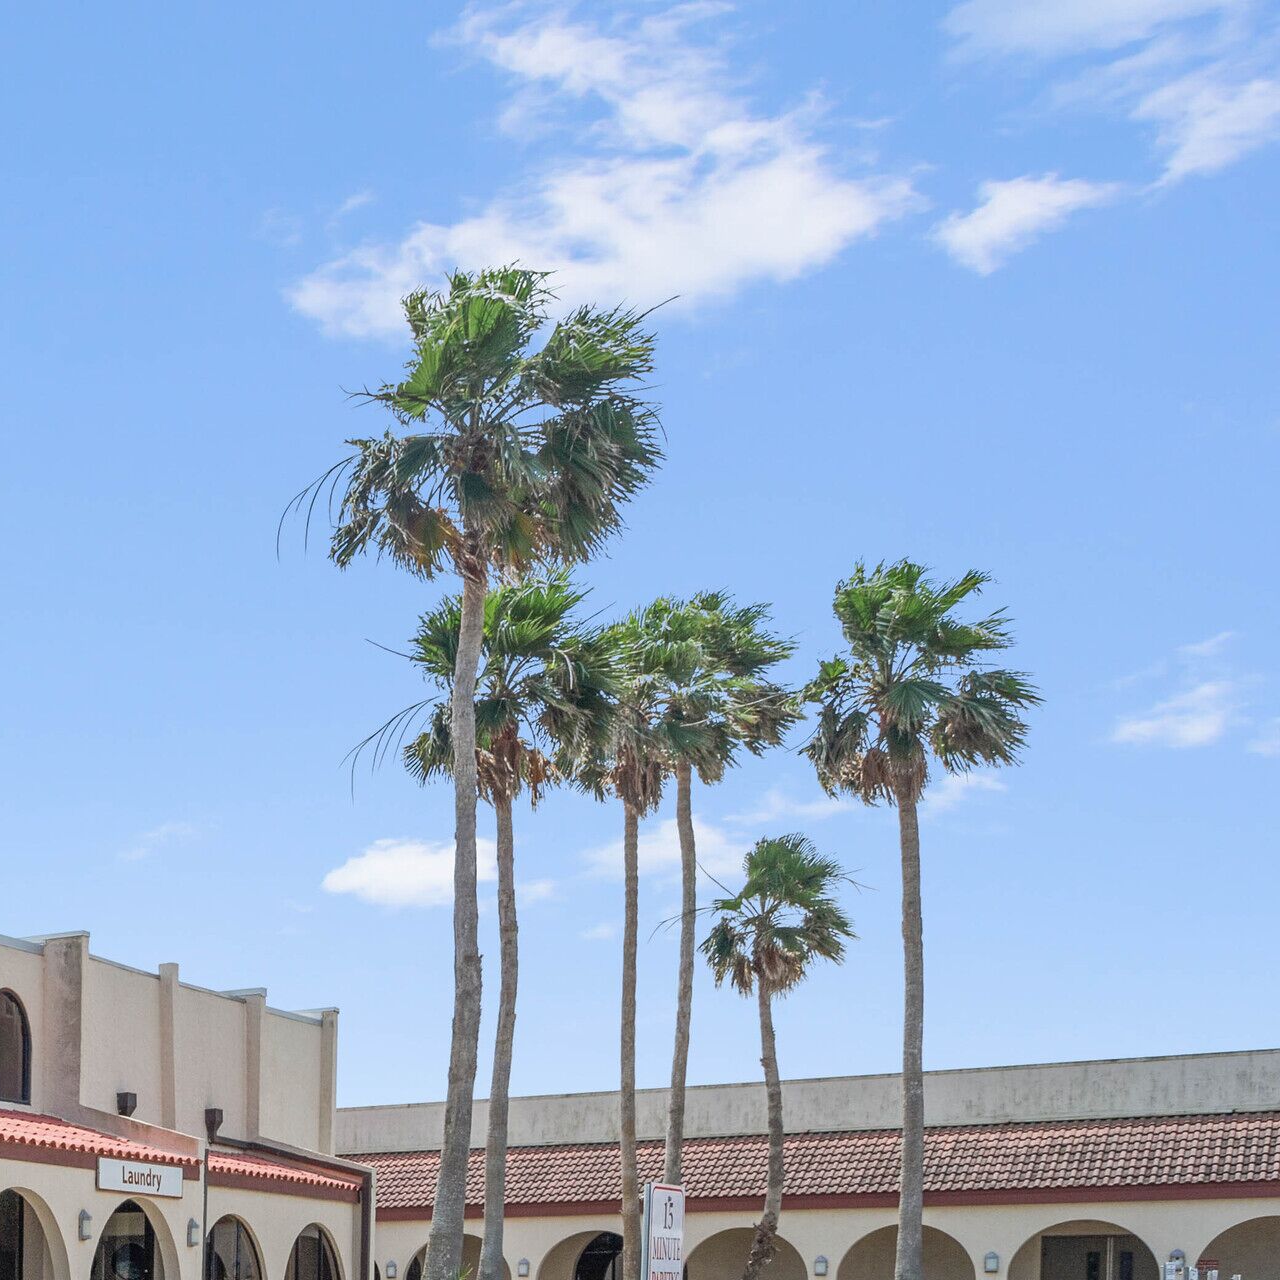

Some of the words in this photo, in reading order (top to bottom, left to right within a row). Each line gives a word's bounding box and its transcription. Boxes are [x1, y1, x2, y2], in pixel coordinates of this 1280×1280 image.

[122, 1165, 162, 1192] Laundry
[663, 1202, 674, 1230] 15
[652, 1236, 681, 1261] MINUTE
